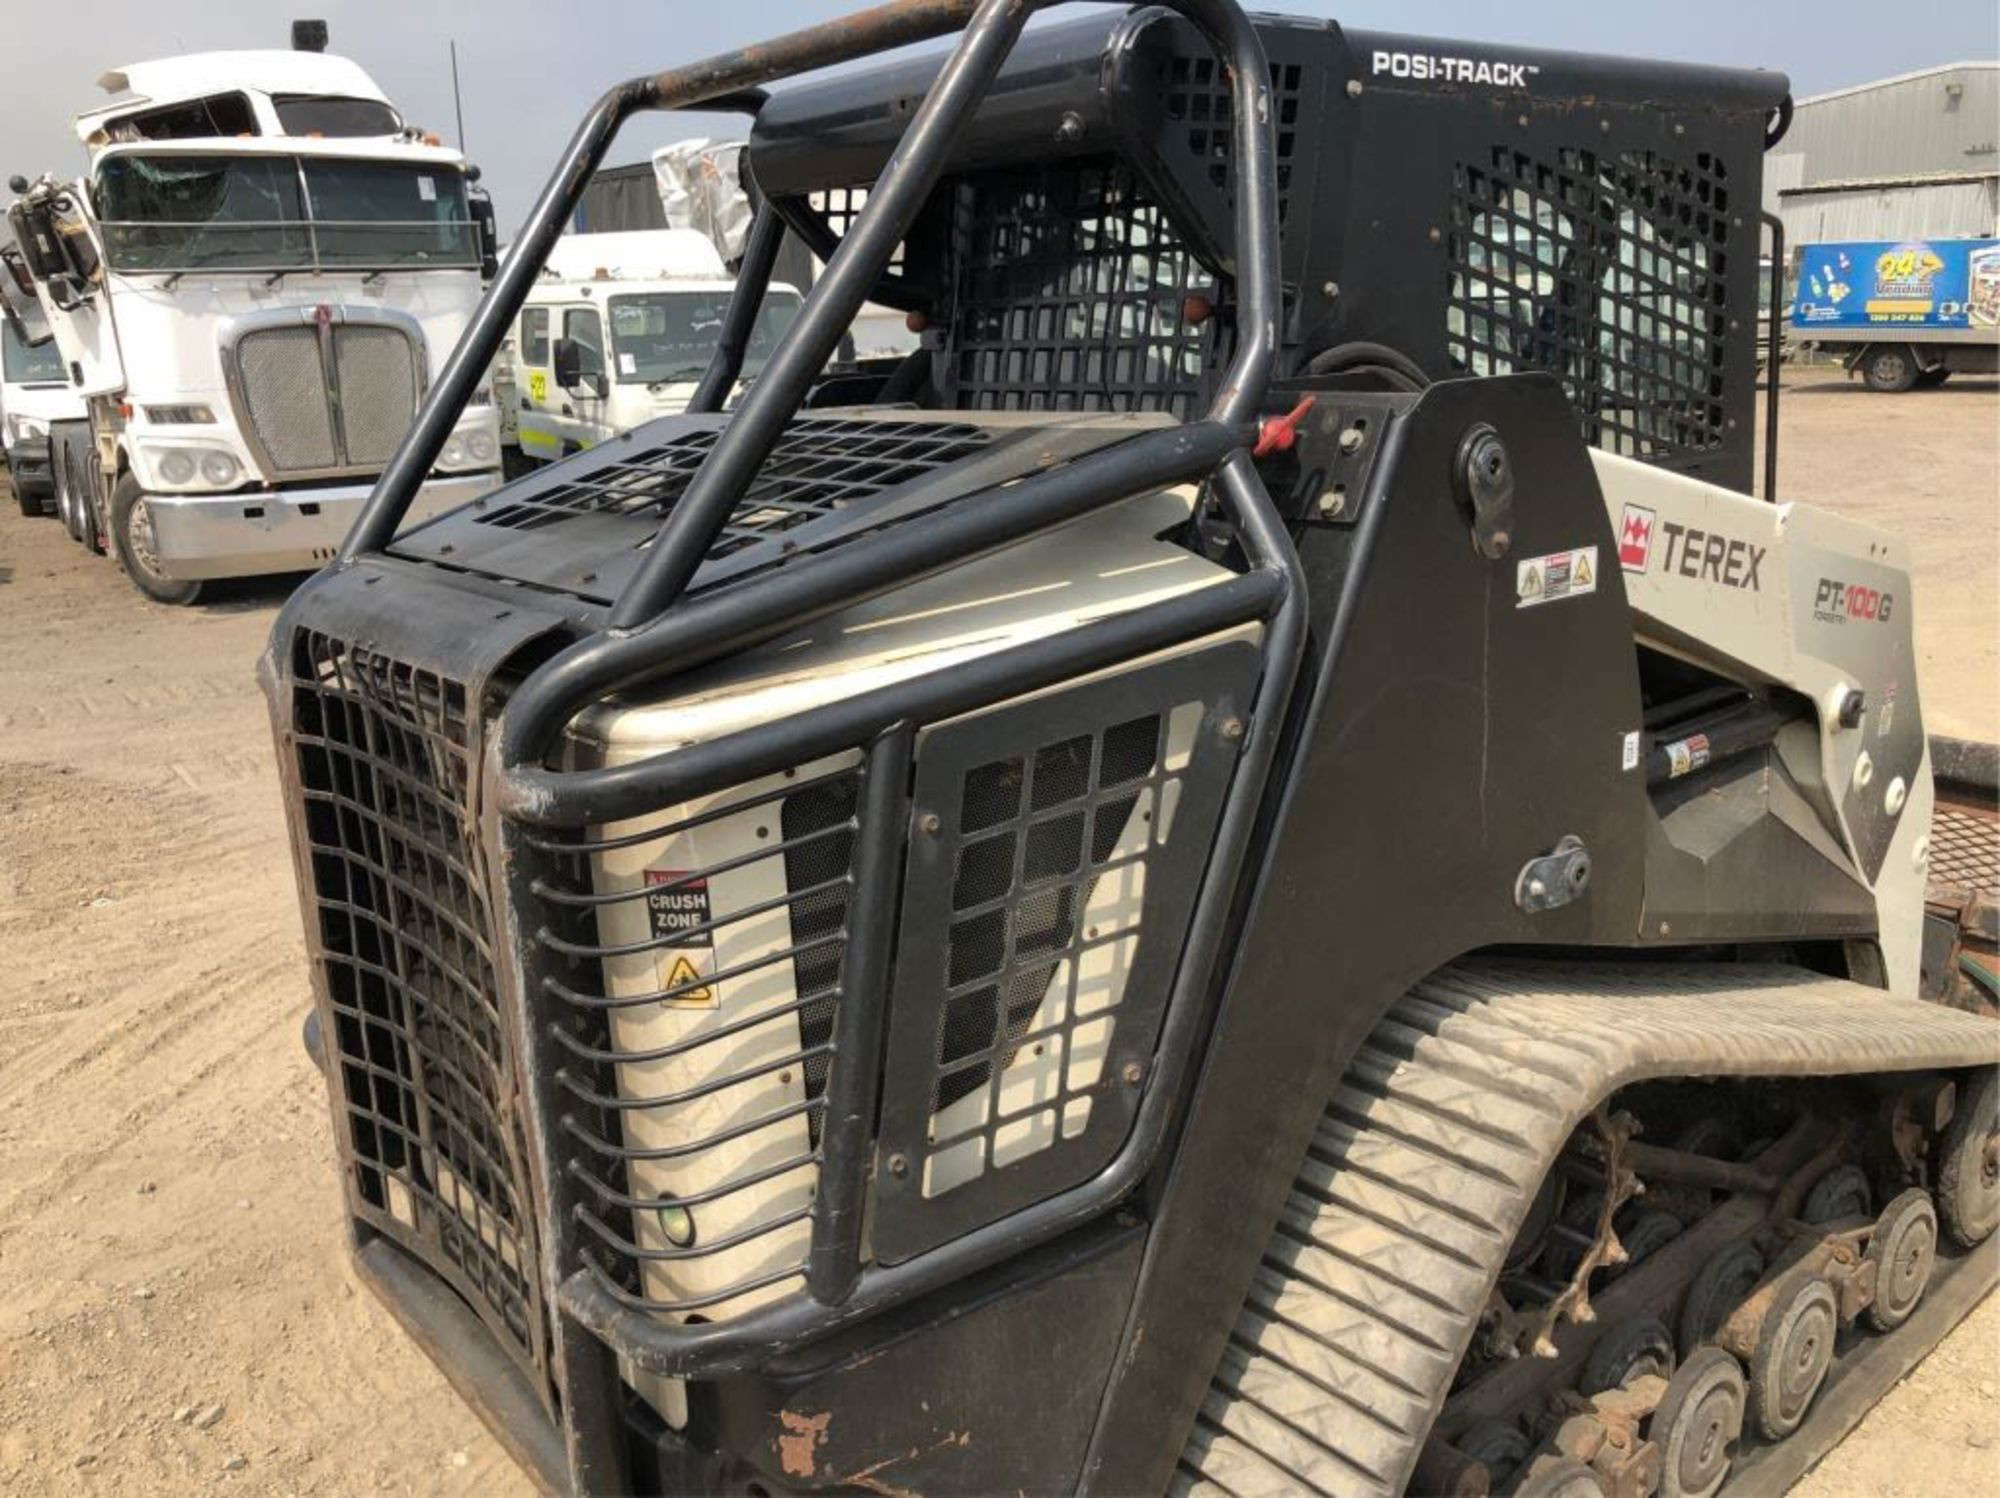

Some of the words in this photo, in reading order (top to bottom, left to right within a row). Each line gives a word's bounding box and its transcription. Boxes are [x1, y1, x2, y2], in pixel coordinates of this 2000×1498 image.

[1373, 51, 1526, 87] POSI-TRACK
[1663, 521, 1766, 591] TEREX
[650, 893, 706, 909] CRUSH
[657, 912, 702, 928] ZONE
